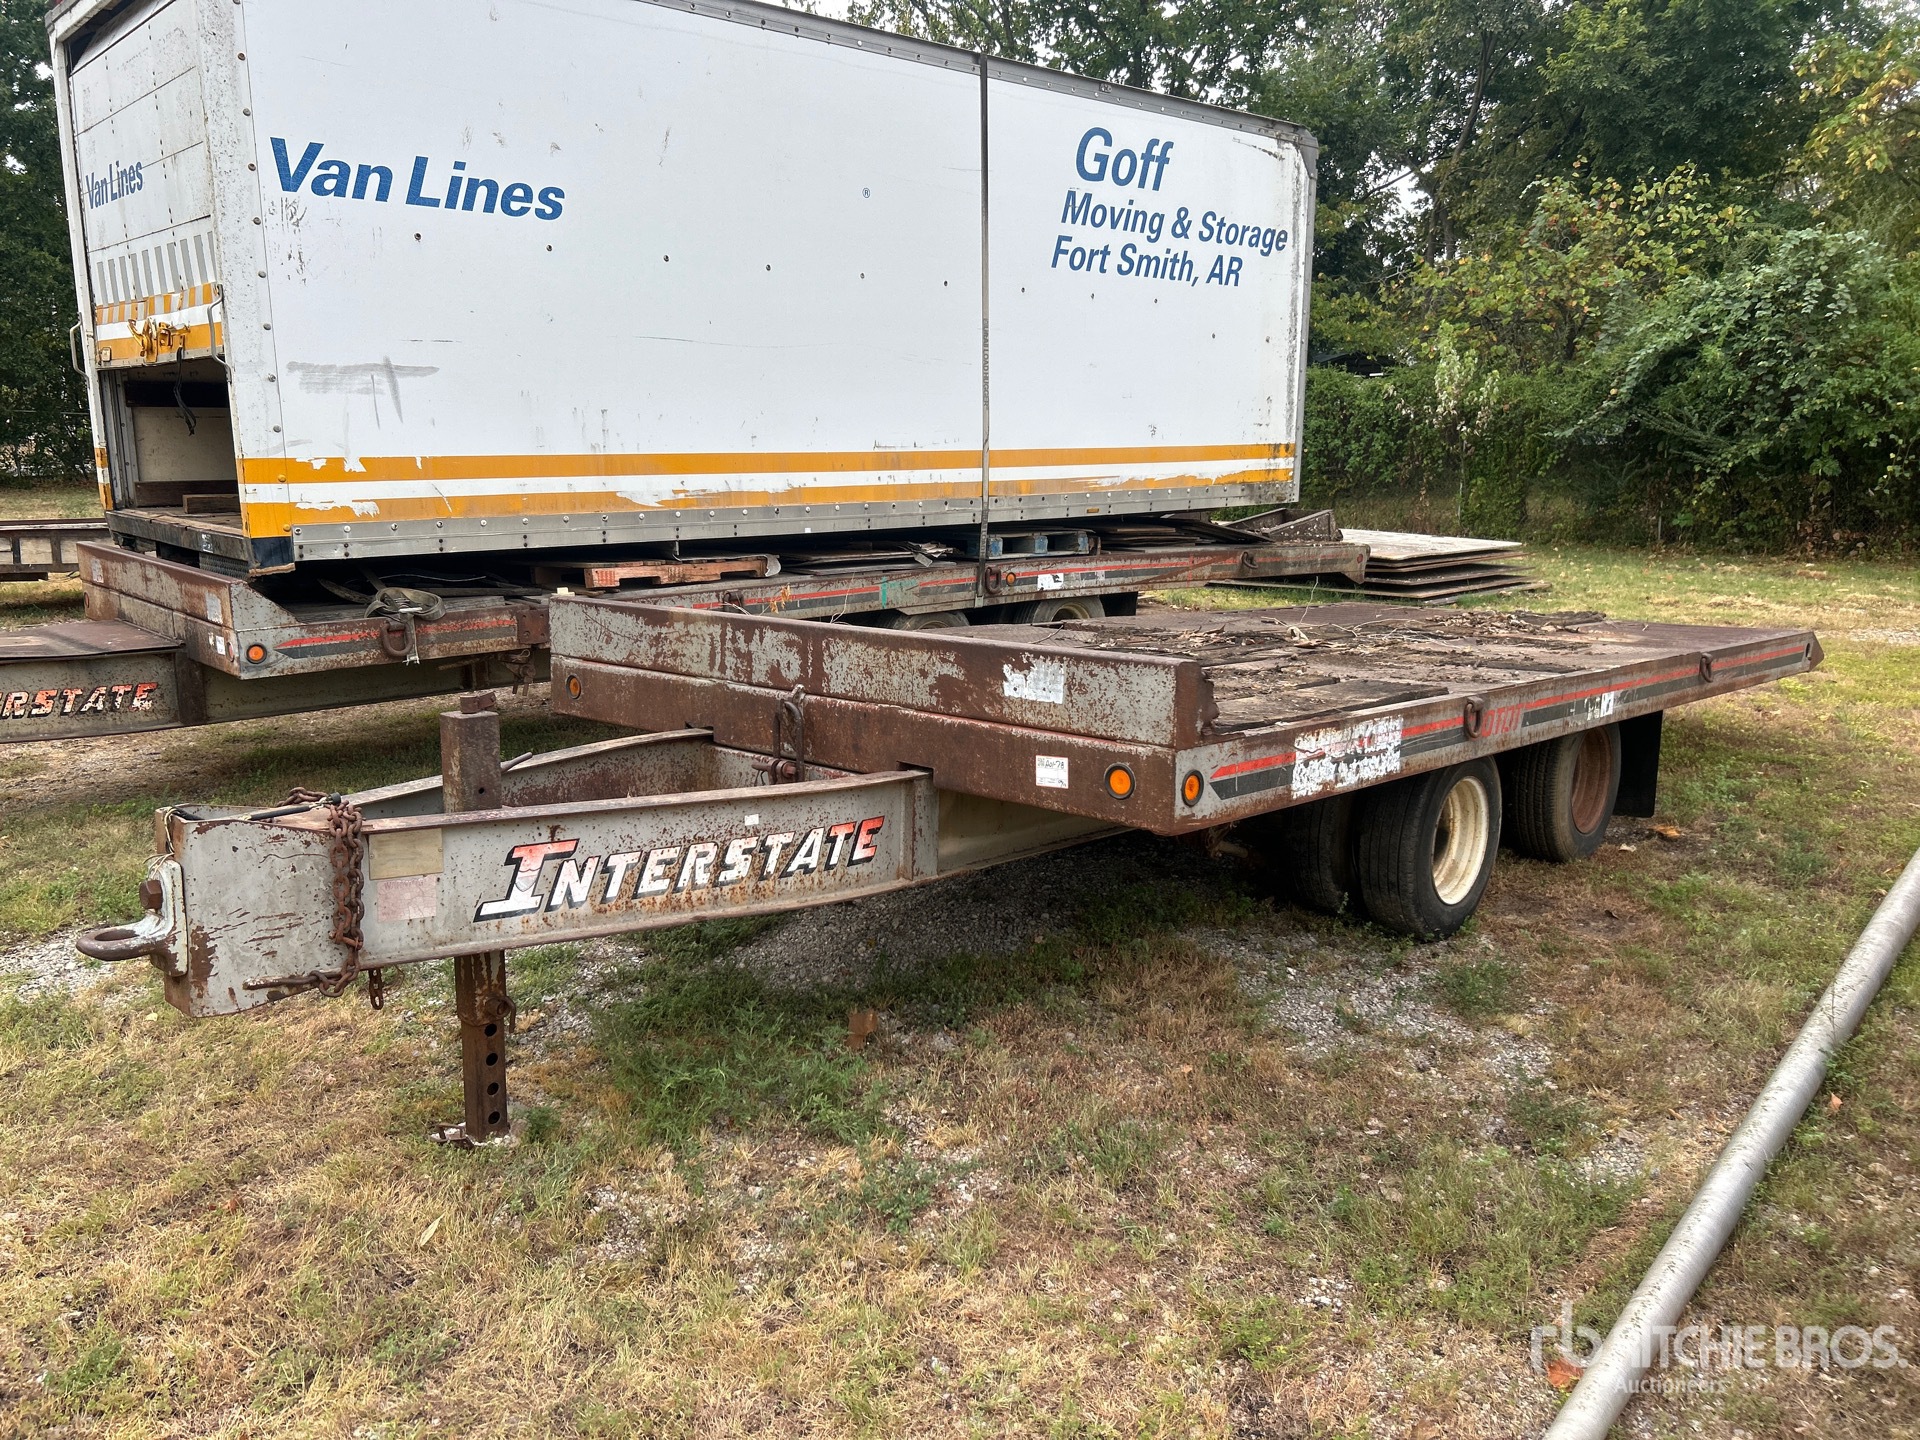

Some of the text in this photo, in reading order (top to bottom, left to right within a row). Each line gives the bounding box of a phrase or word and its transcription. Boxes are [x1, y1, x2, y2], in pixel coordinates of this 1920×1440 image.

[85, 160, 143, 210] Van Lines
[269, 136, 566, 221] Van Lines
[1076, 126, 1174, 192] Goff
[1061, 189, 1289, 257] Moving & Storage
[1051, 234, 1243, 287] Fort Smith, AR
[0, 682, 158, 720] RSTATE
